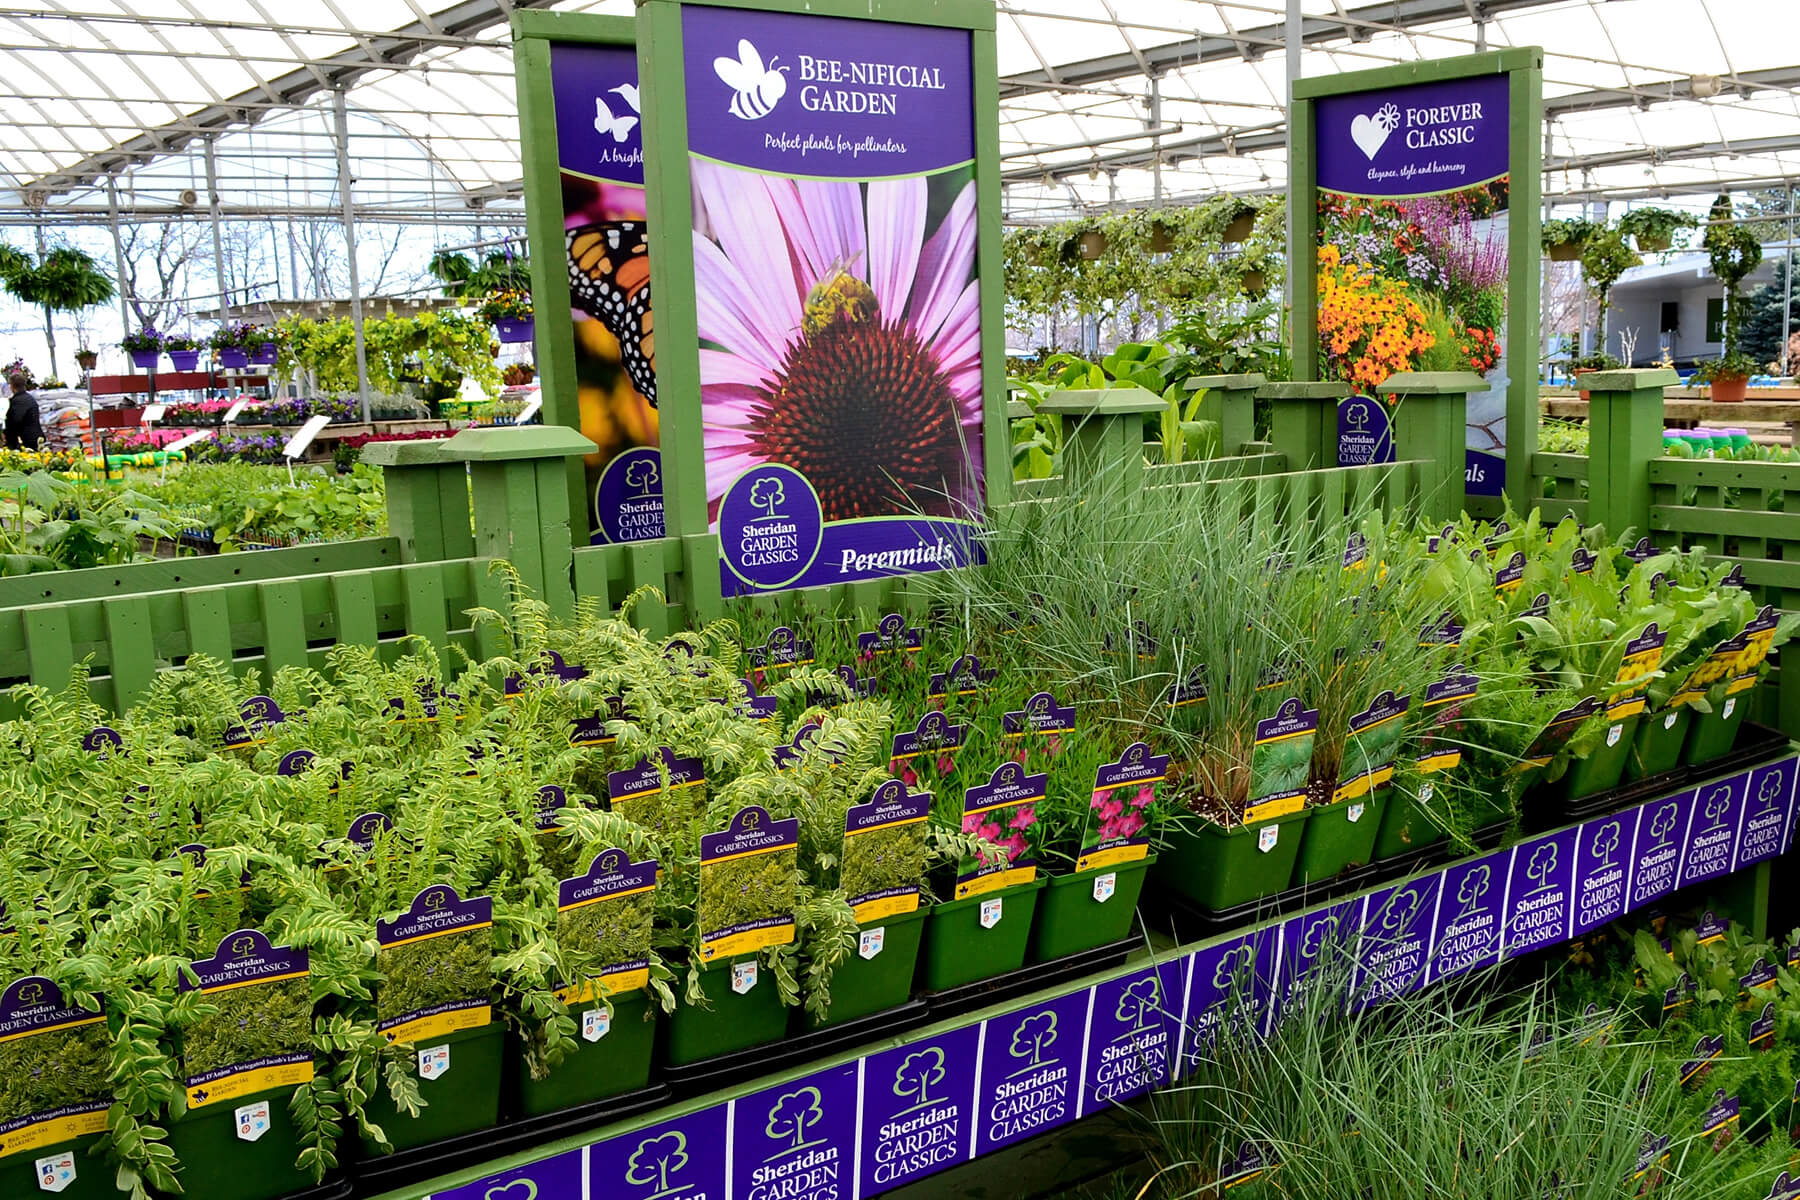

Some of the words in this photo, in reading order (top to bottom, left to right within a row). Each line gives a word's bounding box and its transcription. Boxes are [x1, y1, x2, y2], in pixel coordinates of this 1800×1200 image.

[799, 54, 946, 90] BEE-NIFICIAL
[800, 86, 897, 115] GARDEN
[1406, 102, 1483, 128] FOREVER
[765, 133, 801, 151] Perfect
[802, 135, 835, 154] plants
[836, 137, 853, 156] for
[853, 136, 907, 158] pollinators
[1406, 125, 1475, 149] CLASSIC
[600, 149, 611, 163] A
[1400, 164, 1417, 180] style
[1417, 162, 1432, 175] and
[1432, 160, 1466, 175] harmony
[1338, 443, 1376, 454] GARDEN
[1340, 434, 1375, 445] Sheridan
[1338, 453, 1376, 465] CLASSICS
[619, 501, 664, 515] Sherida
[618, 524, 666, 541] CLASSIC
[742, 522, 797, 538] Sheridan
[740, 534, 798, 553] GARDEN
[839, 537, 952, 573] Perennials
[741, 547, 799, 567] CLASSICS
[623, 776, 656, 791] GARDEN
[1106, 771, 1130, 783] GARDEN
[1130, 767, 1157, 778] CLASSICS
[976, 792, 1005, 806] GARDEN
[1004, 786, 1035, 800] CLASSICS
[993, 784, 1020, 794] Sheridan
[858, 812, 887, 826] GARDEN
[887, 807, 918, 820] CLASSICS
[875, 803, 902, 814] Sheridan
[1747, 812, 1782, 832] Sheridan
[715, 839, 750, 854] GARDEN
[749, 833, 784, 848] CLASSICS
[734, 830, 766, 842] Sheridan
[1693, 829, 1732, 850] Sheridan
[1743, 824, 1780, 848] GARDEN
[1639, 848, 1677, 870] Sheridan
[1688, 842, 1731, 867] GARDEN
[1740, 840, 1778, 864] CLASSICS
[593, 873, 625, 886] Sheridan
[1583, 867, 1623, 892] Sheridan
[1635, 860, 1675, 887] GARDEN
[1685, 857, 1727, 881] CLASSICS
[573, 884, 607, 900] GARDEN
[606, 876, 643, 891] CLASSICS
[1580, 882, 1623, 909] GARDEN
[1634, 876, 1672, 903] CLASSICS
[1516, 890, 1564, 915] Sheridan
[1579, 900, 1620, 927] CLASSICS
[394, 921, 433, 937] GARDEN
[434, 913, 476, 928] CLASSICS
[416, 909, 454, 924] Sheridan
[1444, 913, 1494, 936] Sheridan
[1513, 905, 1564, 933] GARDEN
[1440, 926, 1494, 957] GARDEN
[1511, 922, 1563, 951] CLASSICS
[199, 969, 243, 985] GARDEN
[243, 961, 291, 977] CLASSICS
[223, 956, 265, 971] Sheridan
[1438, 949, 1492, 975] CLASSICS
[0, 1016, 32, 1033] RDEN
[33, 1006, 86, 1025] CLASSICS
[10, 1003, 57, 1020] Sheridan
[287, 1053, 309, 1063] Ladder
[1101, 1031, 1168, 1063] Sheridan
[1097, 1045, 1168, 1083] GARDEN
[995, 1066, 1068, 1101] Sheridan
[1095, 1065, 1165, 1103] CLASSICS
[31, 1107, 66, 1122] Variegated
[66, 1104, 89, 1114] Jacob's
[89, 1101, 113, 1110] Ladder
[991, 1080, 1068, 1122] GARDEN
[878, 1104, 958, 1142] Sheridan
[989, 1101, 1067, 1142] CLASSICS
[874, 1119, 959, 1163] GARDEN
[750, 1146, 839, 1187] Sheridan
[873, 1141, 957, 1184] CLASSICS
[747, 1161, 840, 1200] GARDEN
